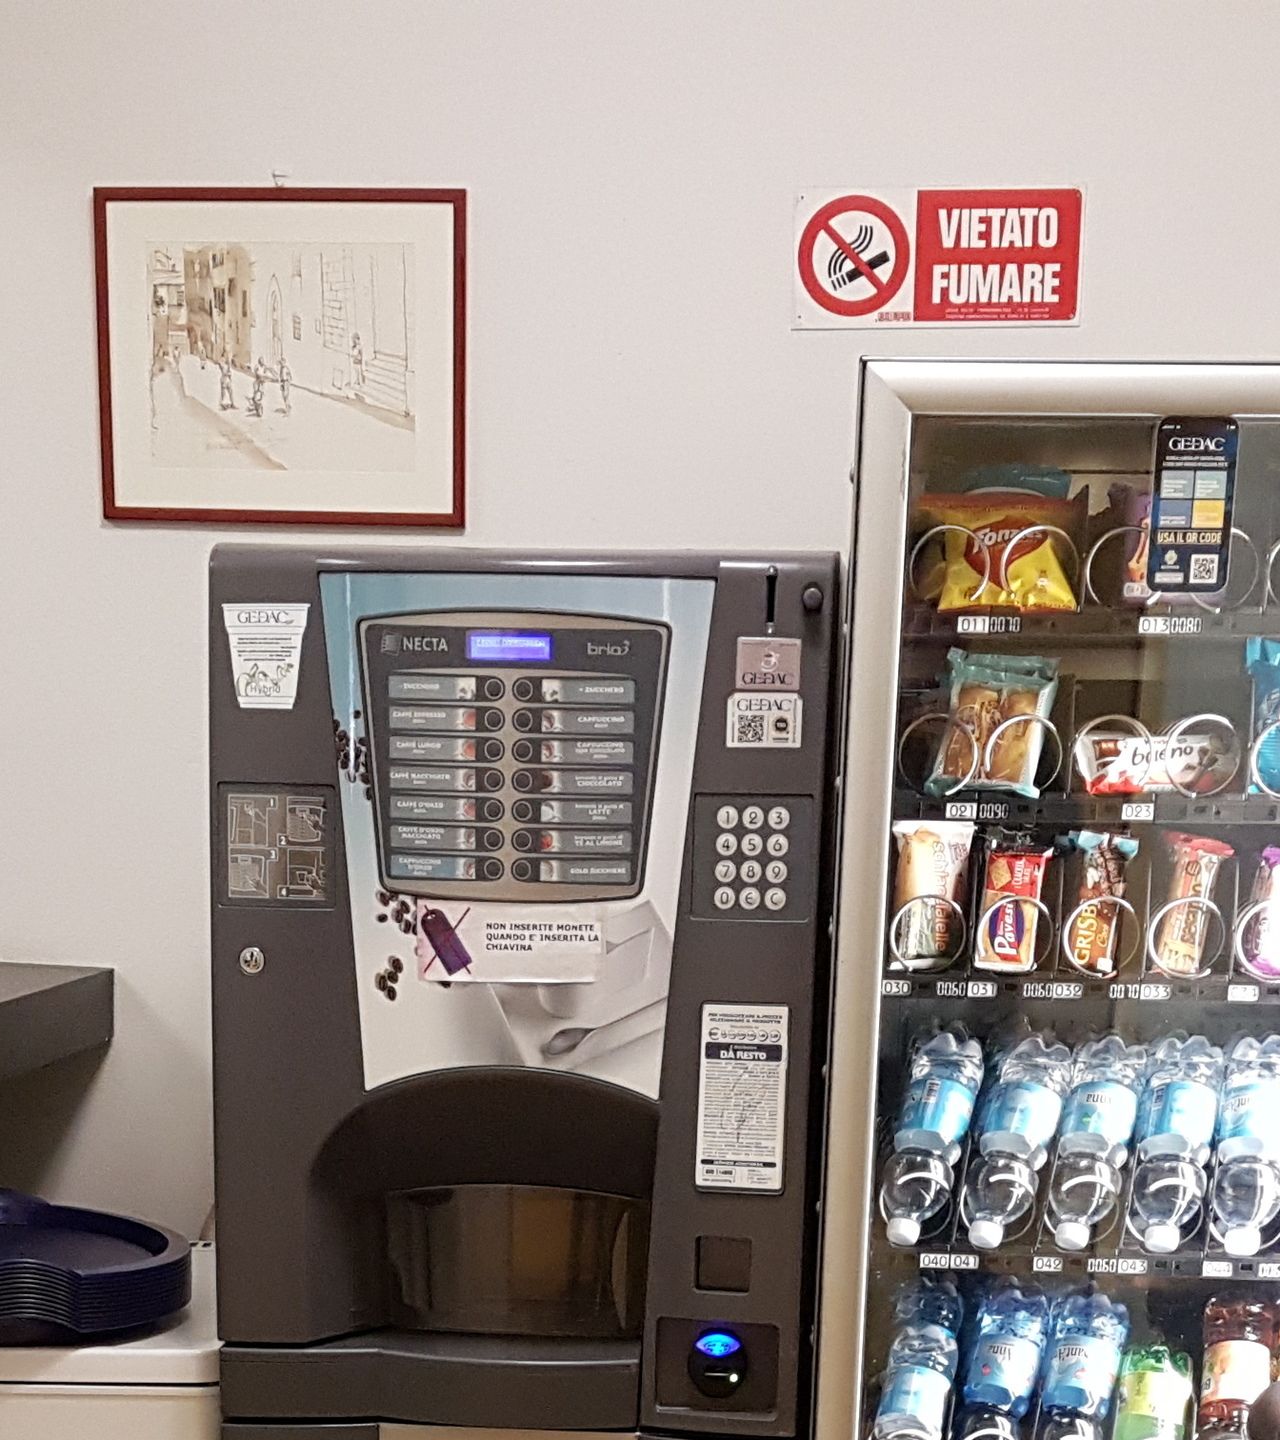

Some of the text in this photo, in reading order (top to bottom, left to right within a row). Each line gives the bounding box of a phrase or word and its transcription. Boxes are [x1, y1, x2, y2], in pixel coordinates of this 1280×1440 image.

[937, 207, 1059, 249] VIETATO
[931, 263, 1061, 304] FUMARE
[1169, 437, 1226, 451] GEDAC
[973, 527, 1043, 554] Fonzes
[1157, 531, 1176, 544] USA
[1177, 531, 1185, 544] IL
[1199, 532, 1222, 544] CODE
[237, 610, 291, 624] GEDAC
[961, 618, 987, 632] 011
[1141, 618, 1169, 632] 013
[403, 637, 449, 652] NECTA
[742, 671, 794, 686] GEDAC
[250, 684, 281, 697] Hybrid
[736, 698, 792, 712] GEDAC
[949, 803, 1009, 818] 021 0090
[1125, 805, 1152, 818] 023
[725, 811, 783, 825] 1 2 3
[280, 836, 287, 845] 2
[722, 838, 782, 852] 4 5 6
[270, 850, 276, 859] 3
[721, 864, 781, 879] 7 8 9
[281, 887, 287, 897] 4
[720, 891, 729, 905] 0
[770, 892, 779, 906] C
[486, 922, 594, 932] NON INSERITE MONETE
[994, 902, 1018, 955] Pavesi
[1074, 903, 1098, 965] GRISB
[486, 932, 526, 942] QUANDO
[540, 933, 585, 942] INSERITA
[588, 934, 599, 942] LA
[485, 943, 533, 951] CHIAVINA
[884, 982, 910, 994] 030
[971, 984, 995, 996] 031
[1055, 985, 1081, 997] 032
[1143, 986, 1170, 998] 033
[736, 1050, 767, 1060] RESTO
[923, 1255, 948, 1267] 040
[954, 1255, 978, 1268] 041
[1036, 1258, 1062, 1270] 042
[1121, 1260, 1146, 1272] 043
